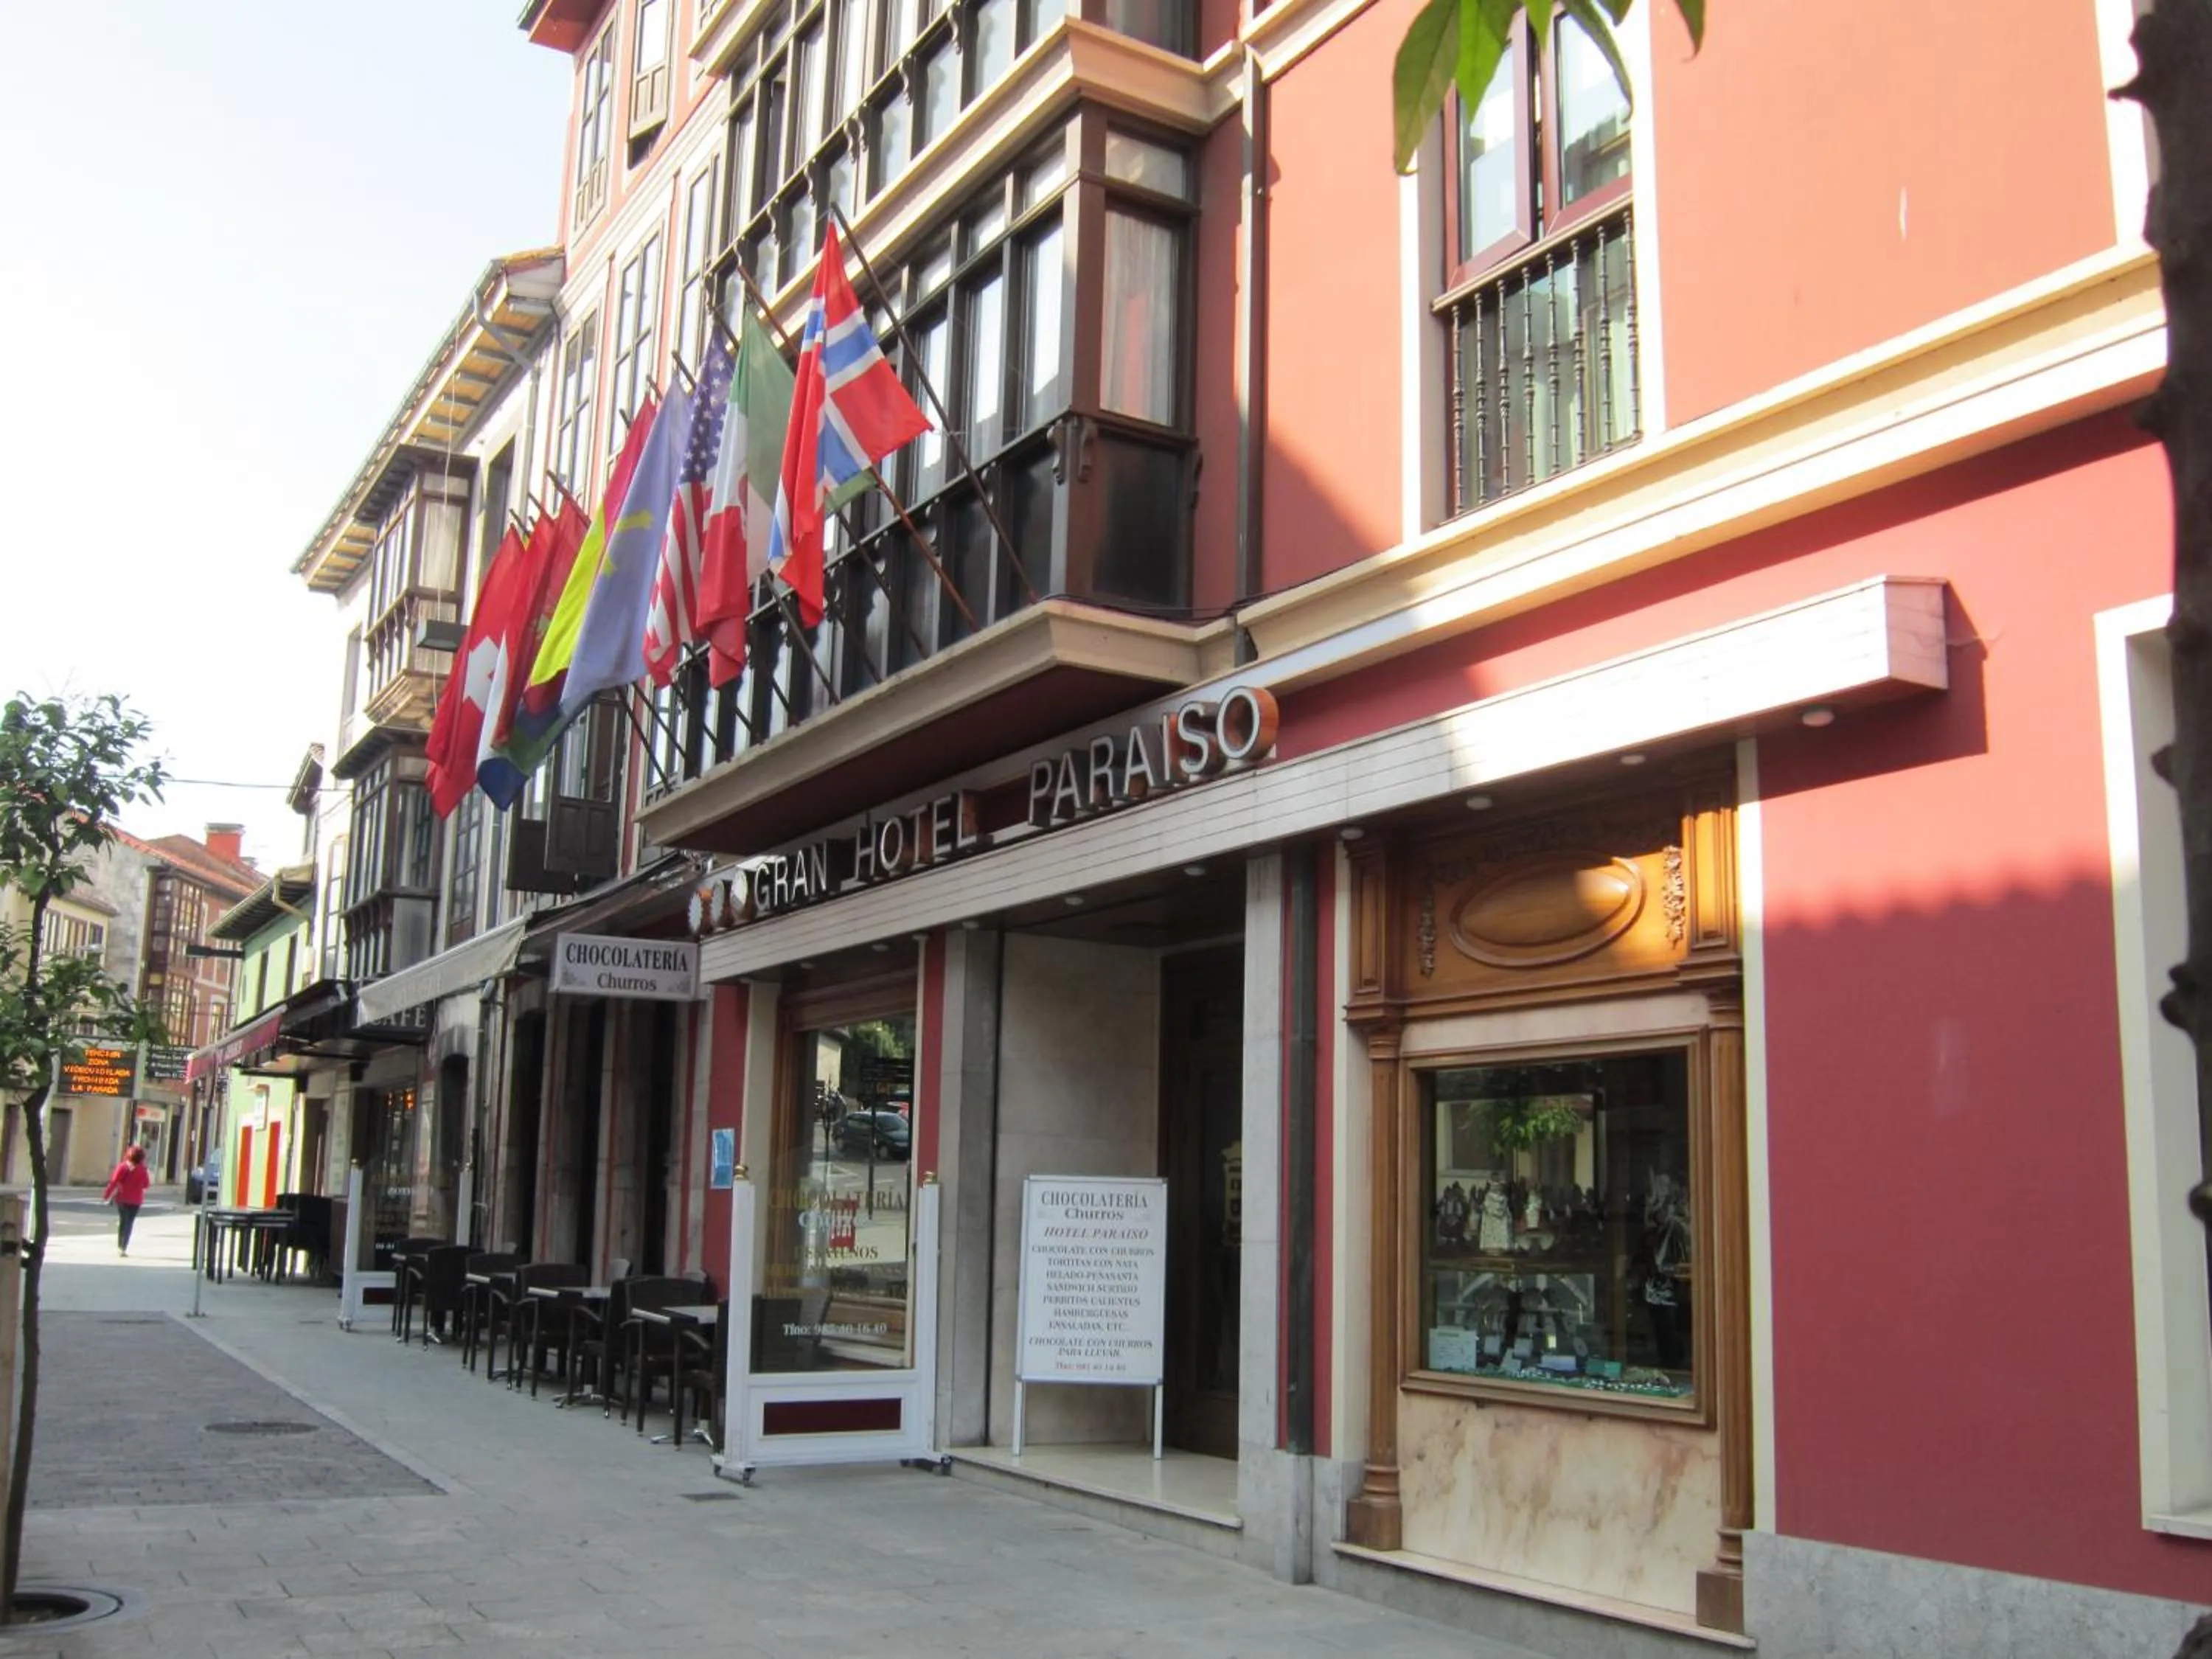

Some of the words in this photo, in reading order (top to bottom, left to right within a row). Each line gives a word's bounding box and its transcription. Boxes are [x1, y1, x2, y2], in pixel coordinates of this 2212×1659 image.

[753, 839, 832, 911] GRAN
[853, 790, 978, 882] HOTEL
[1029, 685, 1265, 825] PARAISO
[566, 942, 689, 972] CHOCOLATERÍA
[597, 973, 658, 992] Churros
[1041, 1189, 1148, 1208] CHOCOLATERÍA
[1065, 1207, 1124, 1220] Churros
[1043, 1226, 1087, 1238] HOTEL
